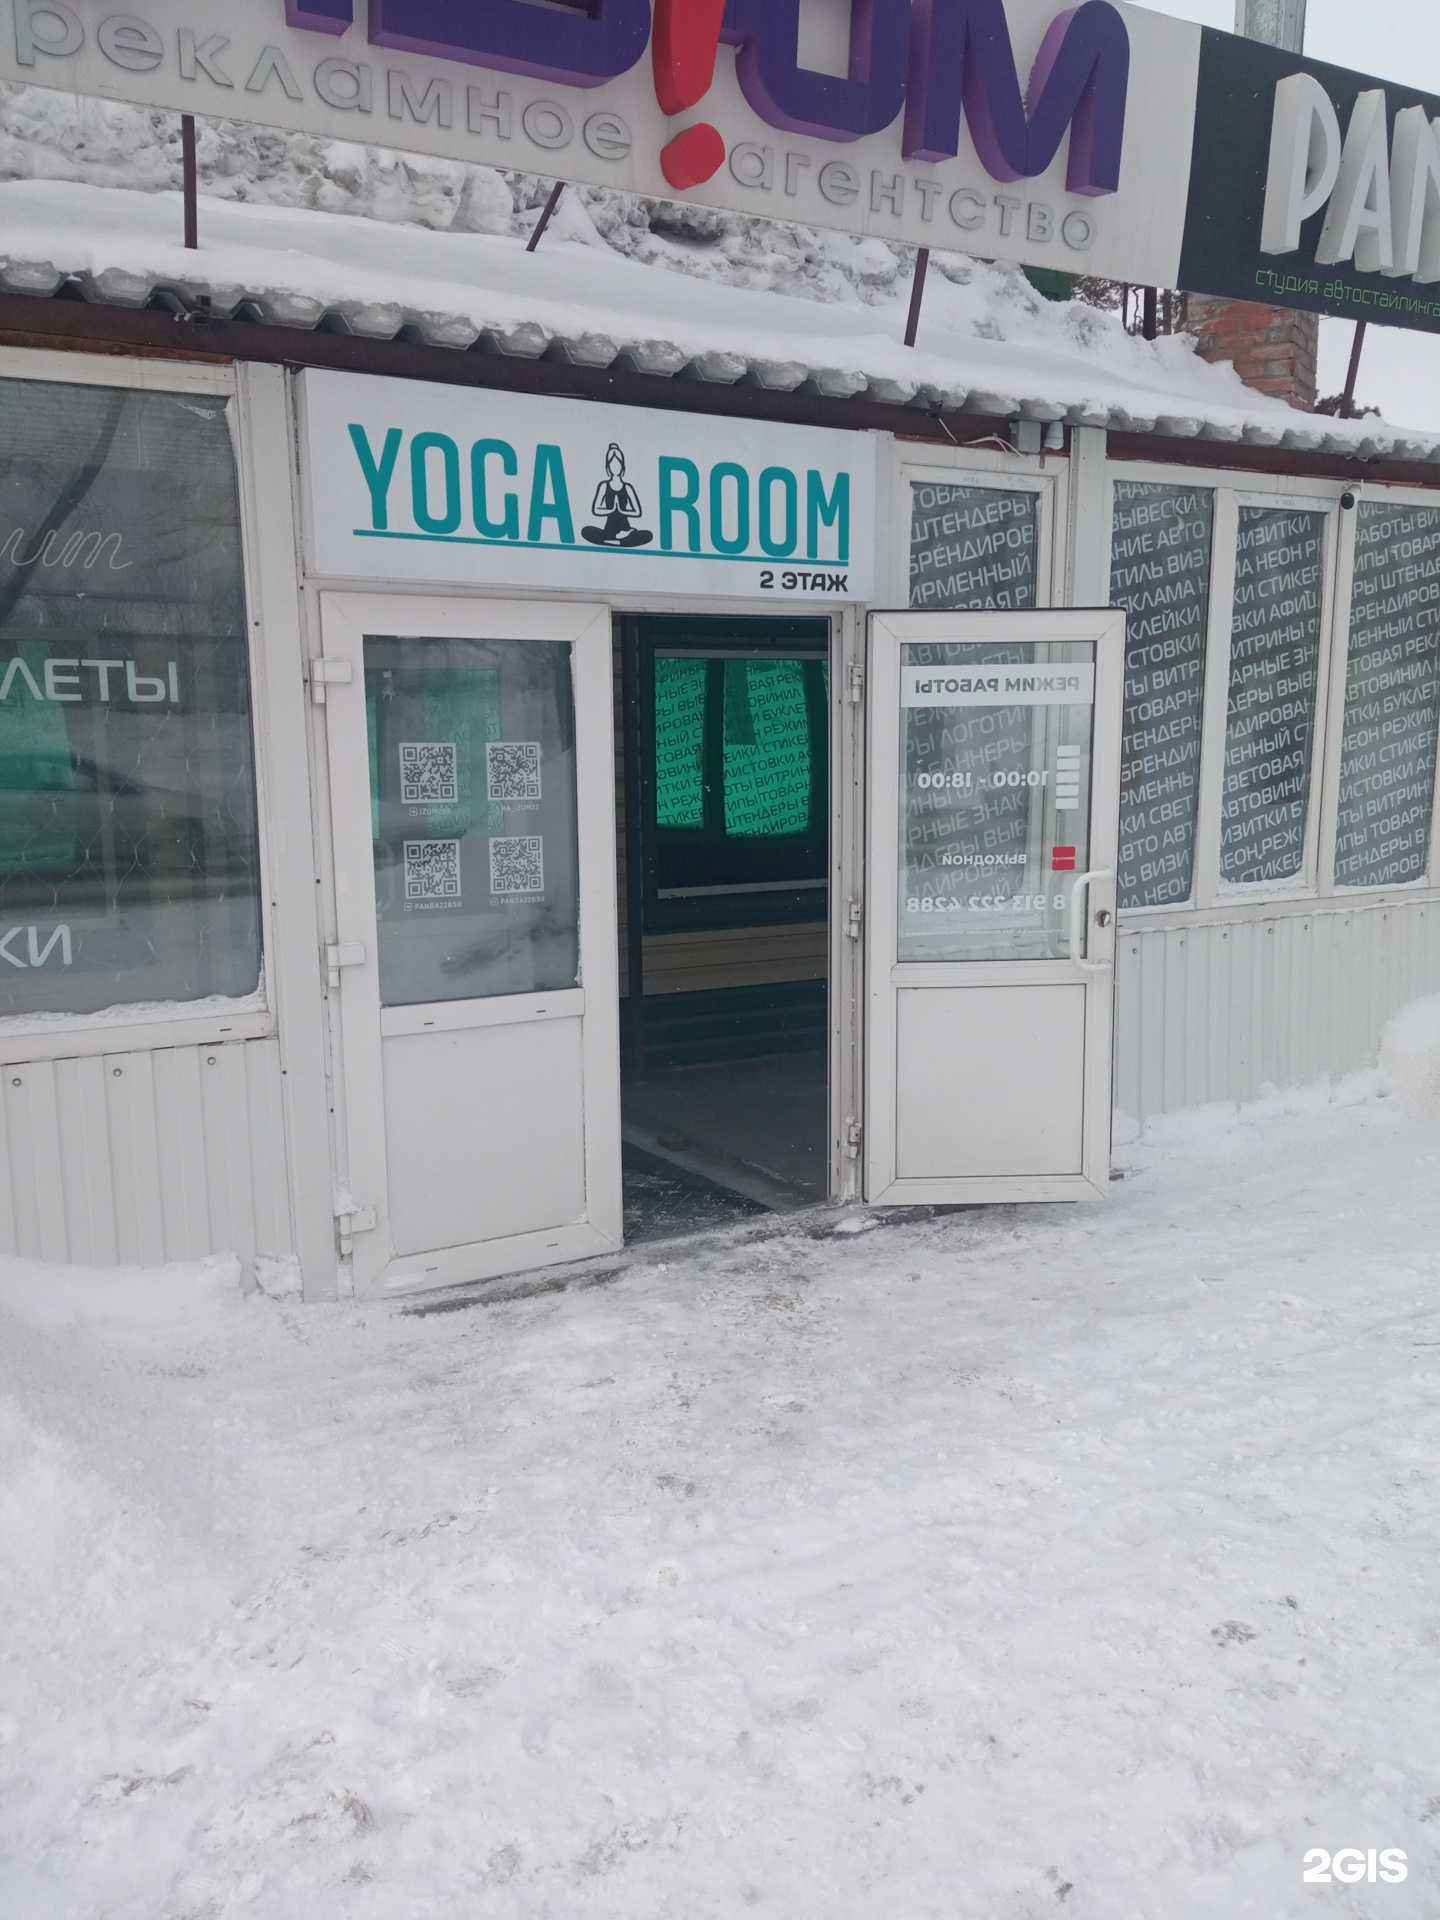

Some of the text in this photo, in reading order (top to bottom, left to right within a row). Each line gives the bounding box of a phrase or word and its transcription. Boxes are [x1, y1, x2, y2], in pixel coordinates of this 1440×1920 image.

[11, 0, 1098, 252] рекламное агентство
[1255, 267, 1319, 295] студия
[347, 423, 850, 561] YOGA ROOM
[760, 571, 849, 593] 2 ЭТАЖ
[1110, 561, 1163, 592] ТИЛЬ
